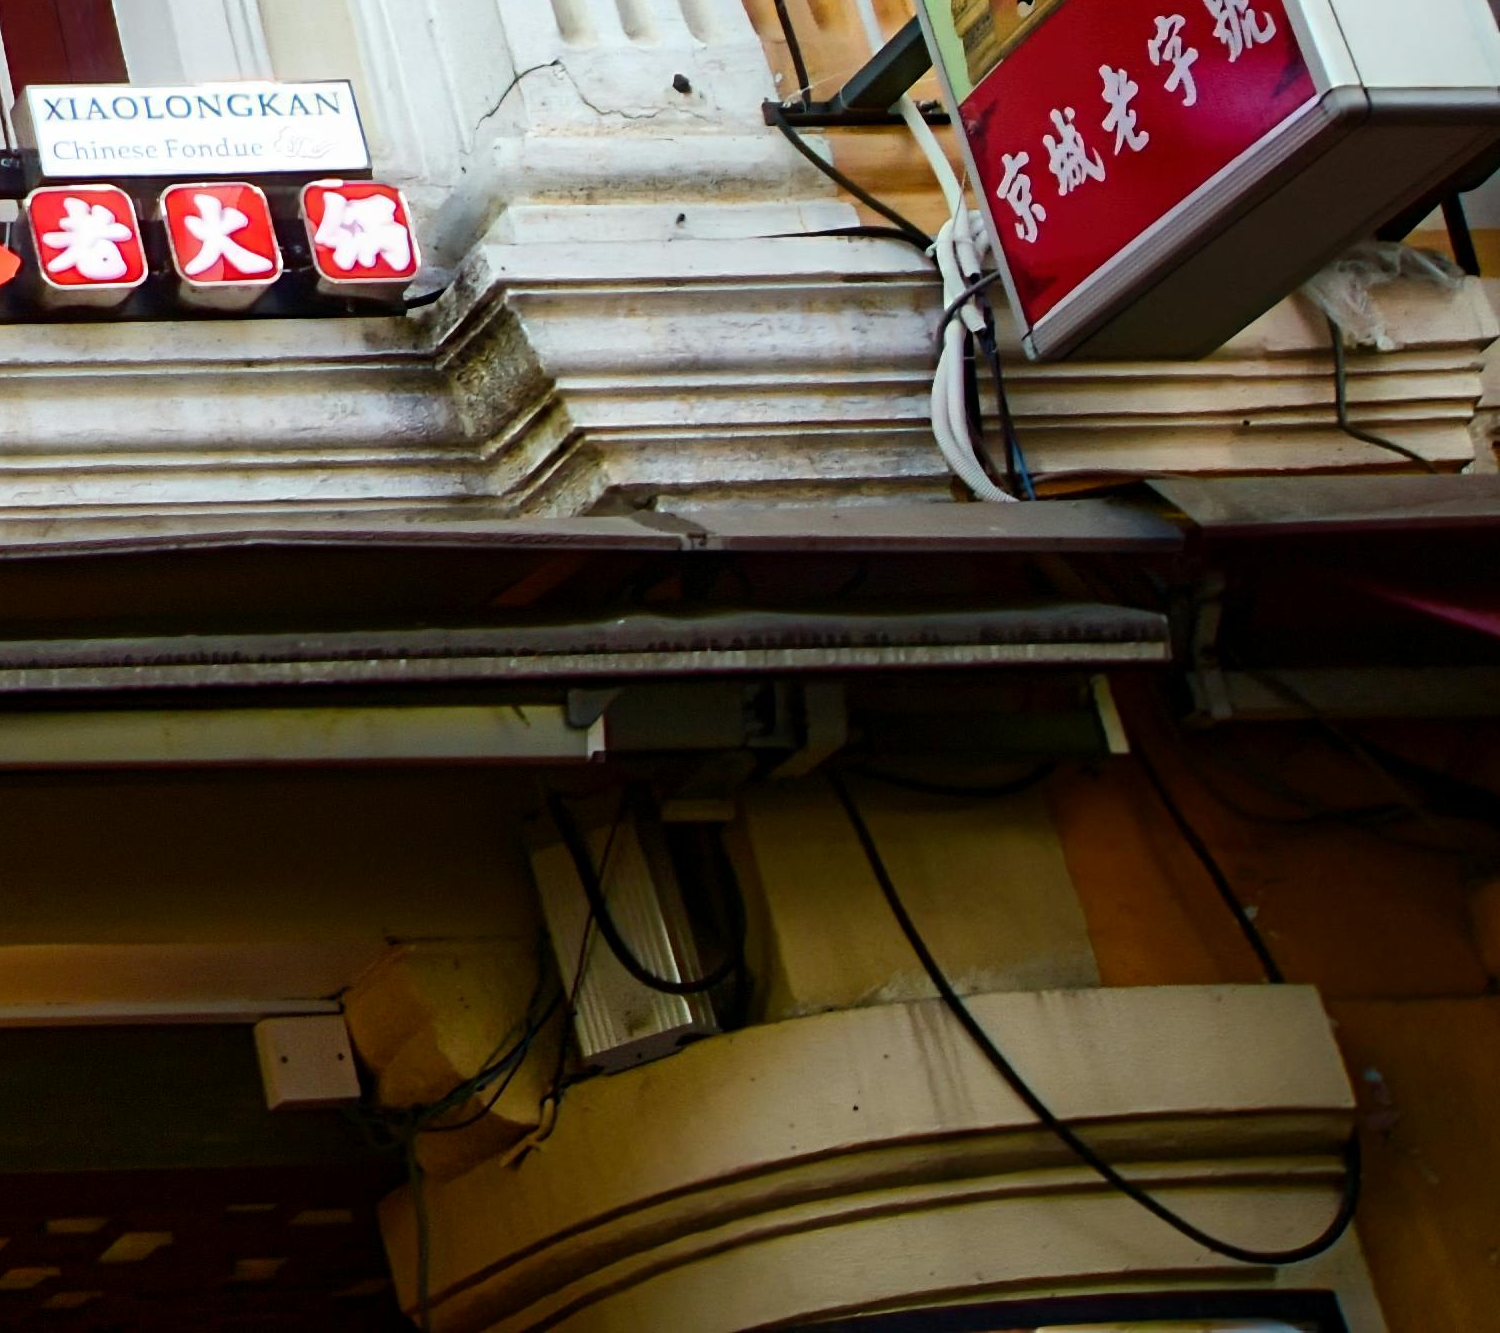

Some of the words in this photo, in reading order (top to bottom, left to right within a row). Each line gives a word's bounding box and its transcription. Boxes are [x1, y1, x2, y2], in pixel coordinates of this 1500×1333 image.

[43, 91, 341, 121] XIAOLONGKAN
[53, 139, 159, 162] Chinese
[166, 137, 264, 159] Fondue
